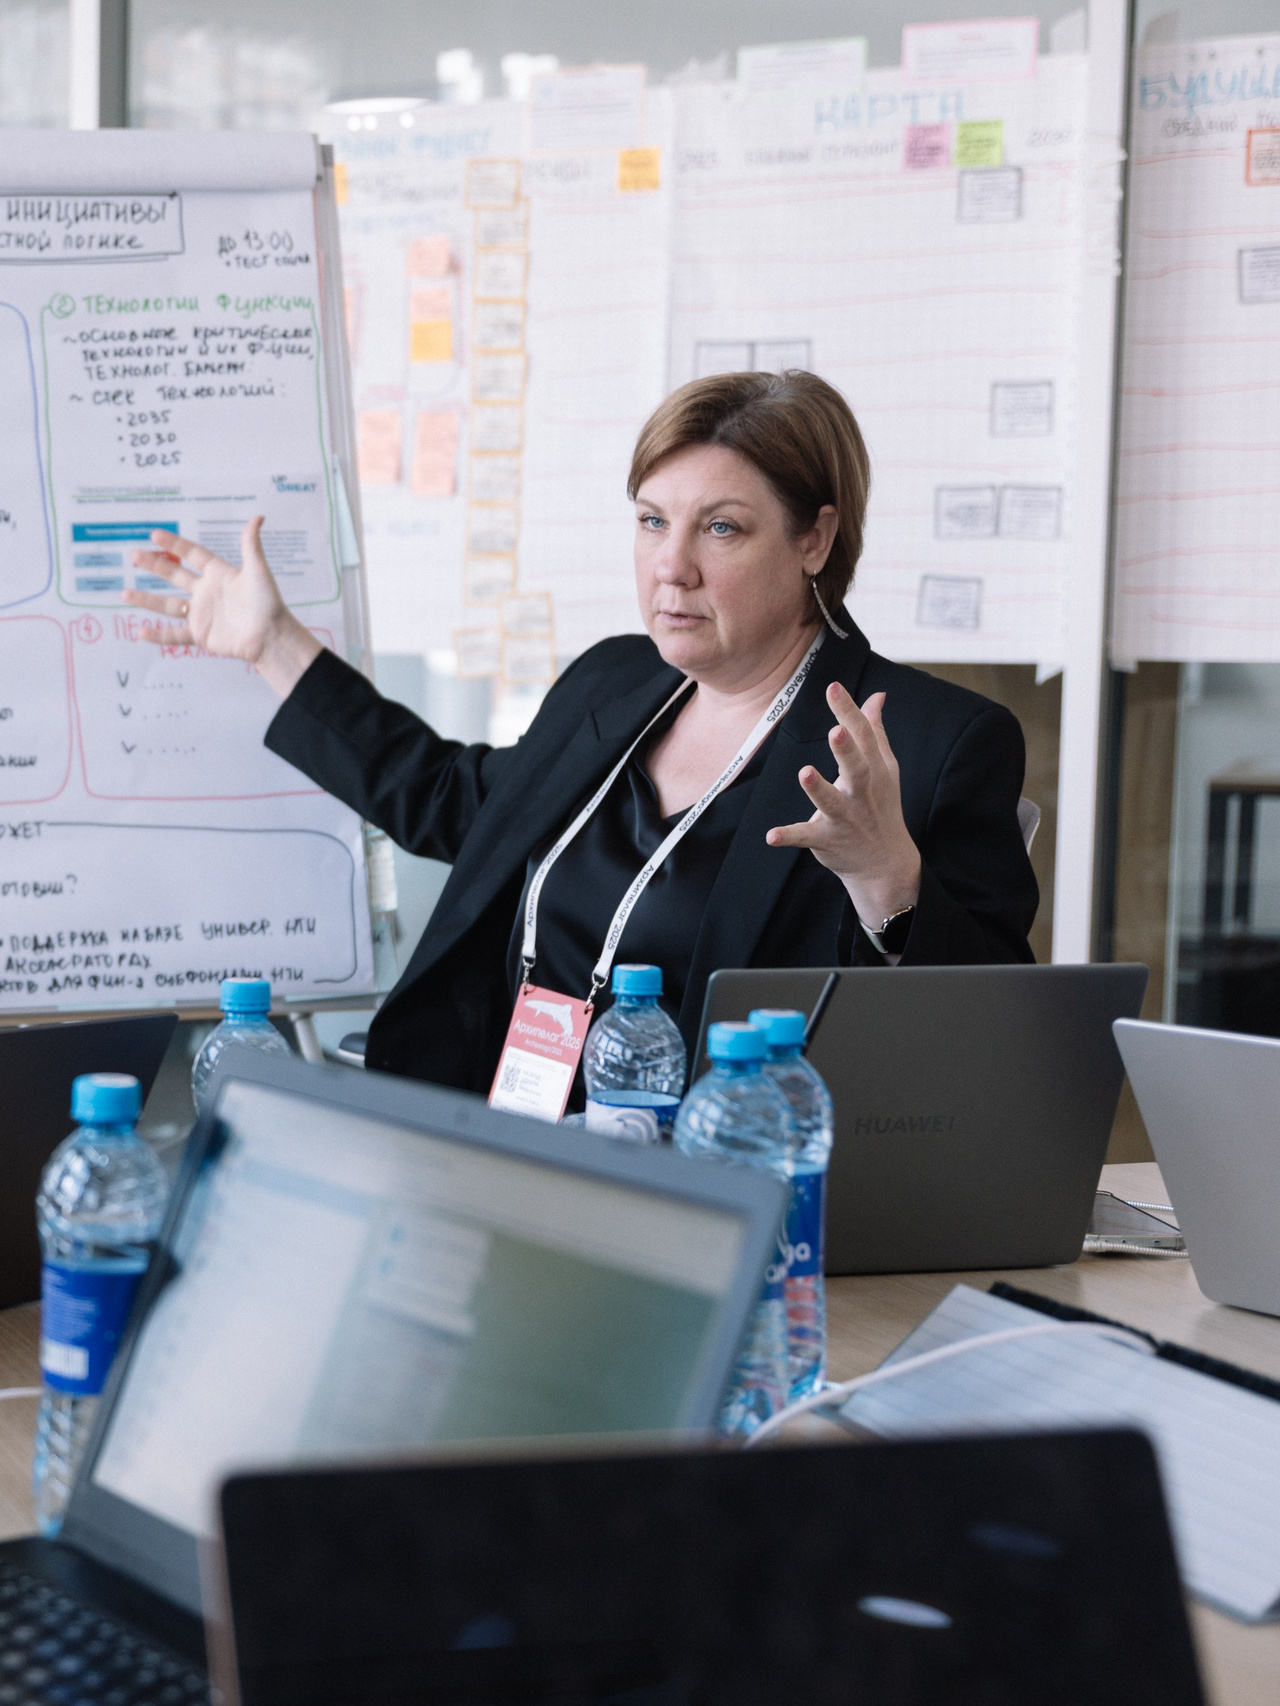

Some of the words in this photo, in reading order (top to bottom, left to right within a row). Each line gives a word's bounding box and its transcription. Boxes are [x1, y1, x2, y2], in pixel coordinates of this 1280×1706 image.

[7, 199, 167, 229] ИНИЦИАТИВЫ
[82, 295, 199, 315] ТЕХНОЛОГИИ
[127, 409, 171, 427] 2035
[129, 432, 177, 448] 2030
[134, 451, 182, 468] 2025
[854, 1115, 955, 1135] HUAWEI
